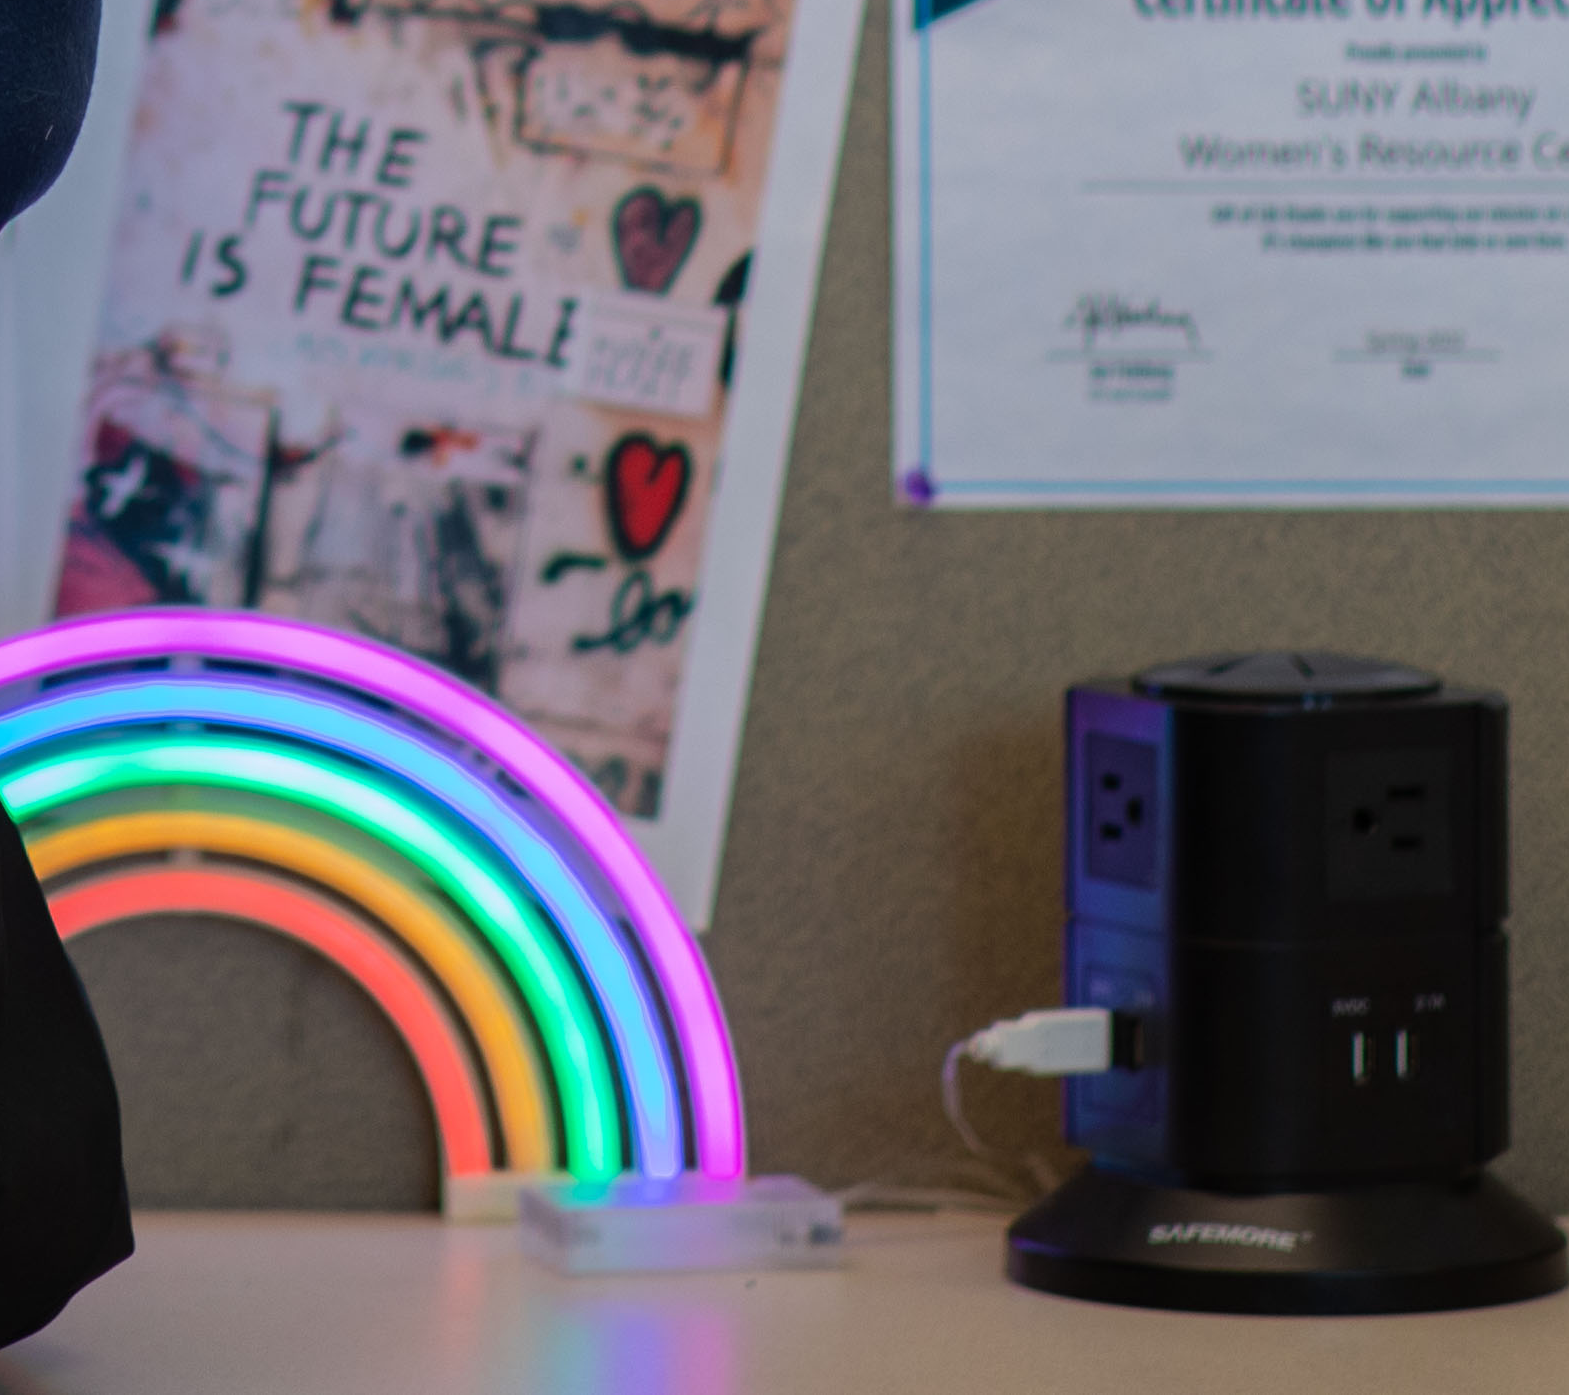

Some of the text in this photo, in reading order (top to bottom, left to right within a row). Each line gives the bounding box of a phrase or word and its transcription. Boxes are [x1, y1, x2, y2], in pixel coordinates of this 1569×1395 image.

[1295, 79, 1537, 125] SUNY Albany
[283, 101, 431, 188] THE
[1178, 133, 1349, 172] Women's
[1358, 132, 1525, 172] Resource
[245, 169, 524, 278] FUTURE
[180, 227, 248, 299] IS
[1147, 1222, 1298, 1253] SAFEMORE
